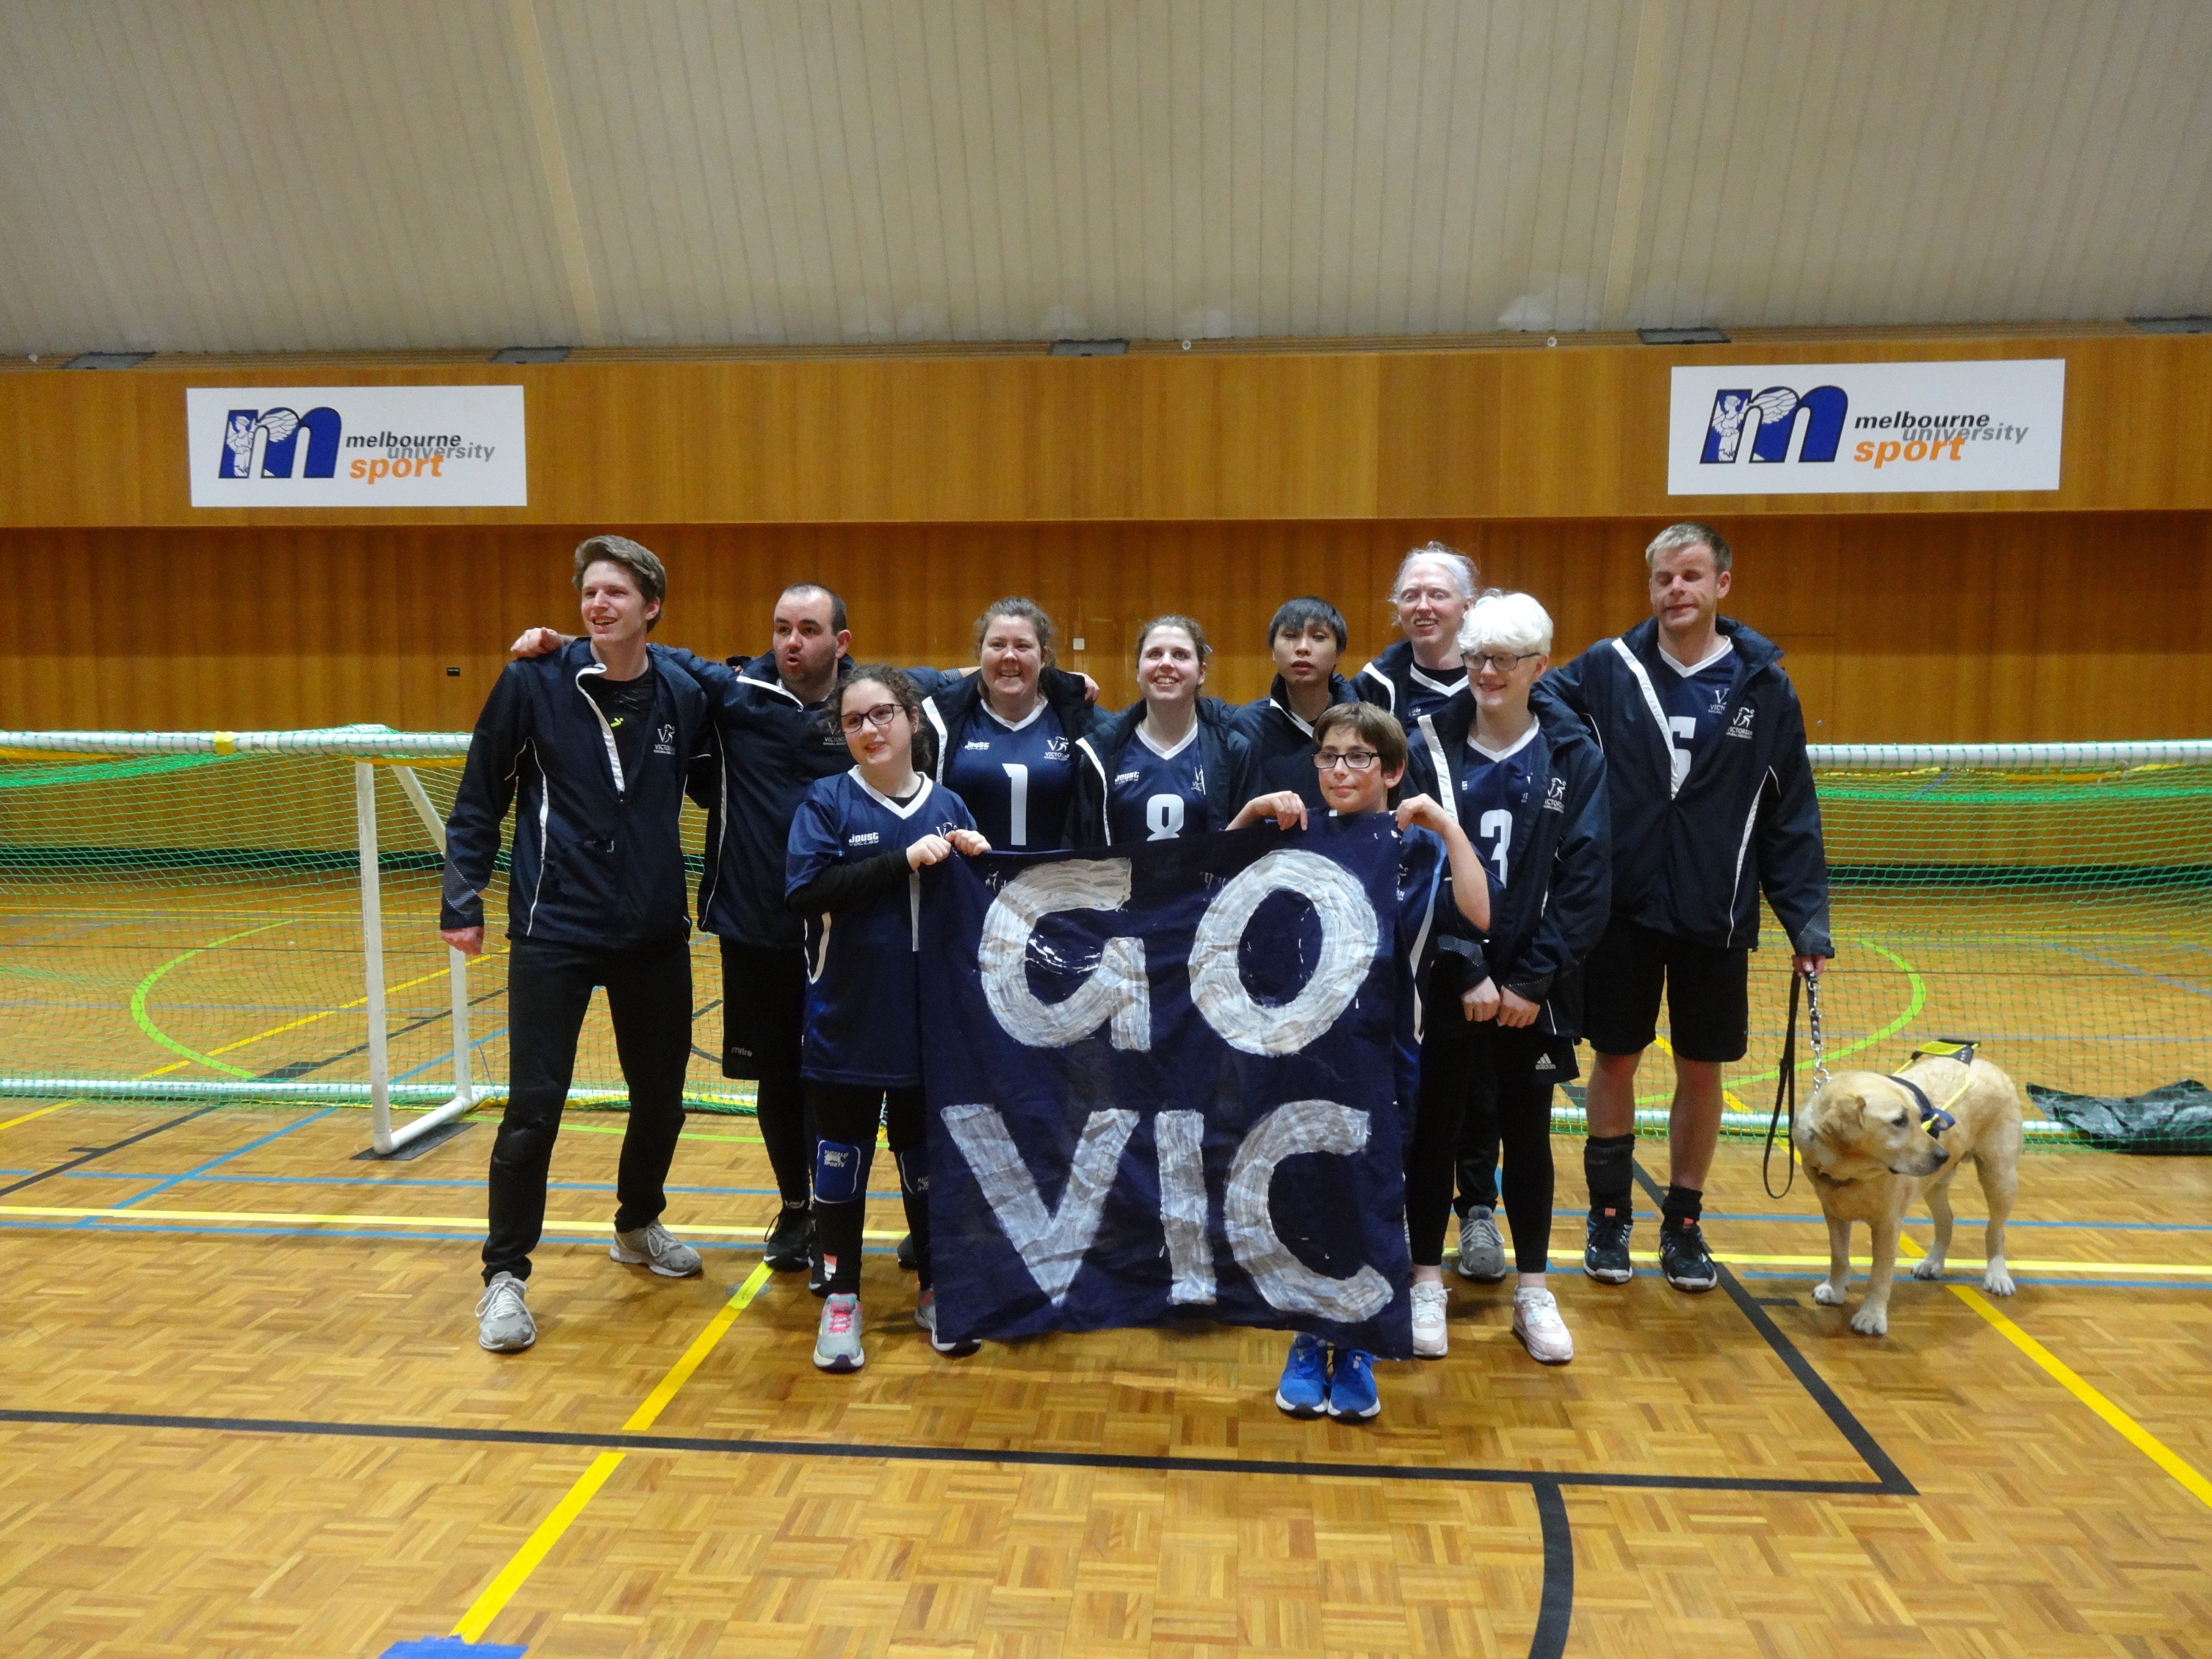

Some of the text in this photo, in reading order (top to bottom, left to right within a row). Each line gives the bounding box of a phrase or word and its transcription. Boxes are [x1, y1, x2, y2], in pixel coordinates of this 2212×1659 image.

[1854, 411, 1990, 429] melbourne
[1902, 422, 2029, 444] university
[346, 431, 462, 449] melbourne
[387, 442, 496, 463] university
[1853, 436, 1965, 469] sport
[349, 454, 444, 485] sport
[1002, 763, 1028, 846] 1
[1480, 809, 1513, 889] 3
[978, 848, 1379, 1057] GO
[940, 1100, 1394, 1323] VIC
